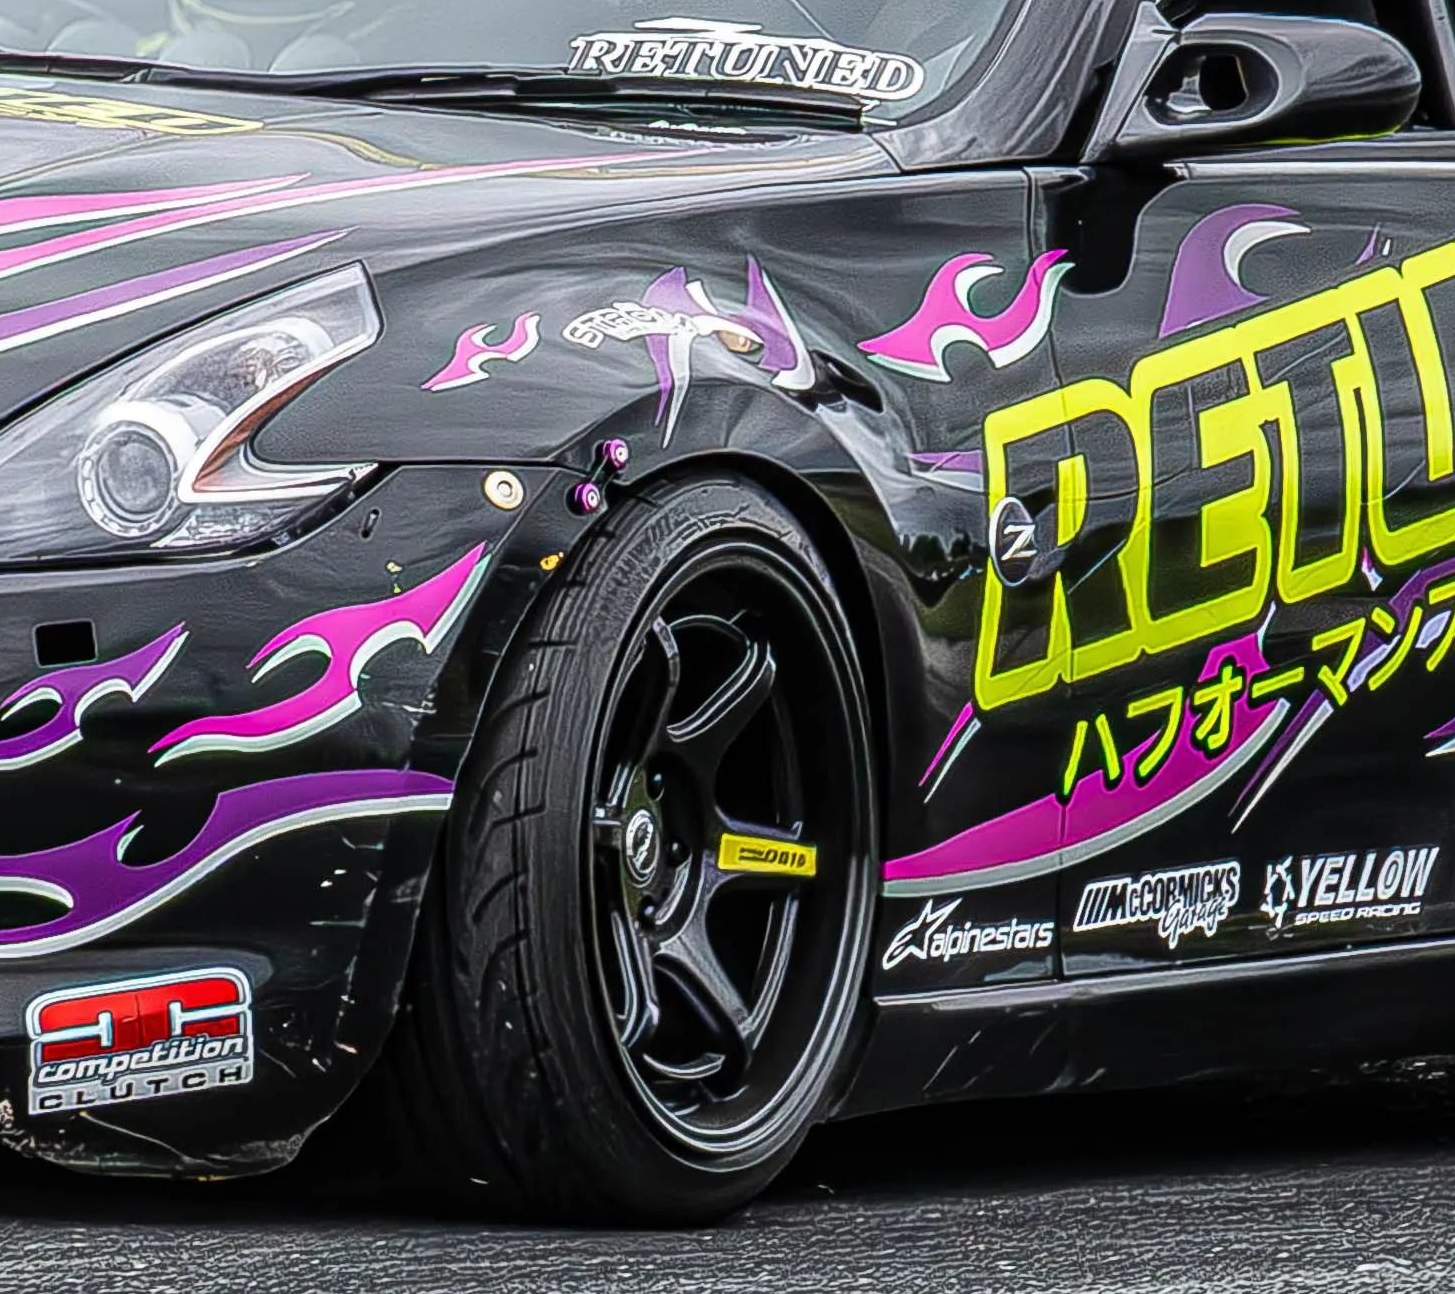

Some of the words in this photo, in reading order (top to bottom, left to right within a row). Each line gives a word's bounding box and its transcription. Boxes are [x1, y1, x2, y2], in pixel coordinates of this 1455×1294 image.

[567, 31, 925, 100] RETUNED
[1297, 846, 1439, 907] YELLOW
[1295, 907, 1352, 926] SPEED
[1355, 902, 1421, 919] RACING
[931, 918, 1054, 962] alpinestars
[37, 1034, 244, 1083] competition
[39, 1064, 243, 1111] CLUTCH
